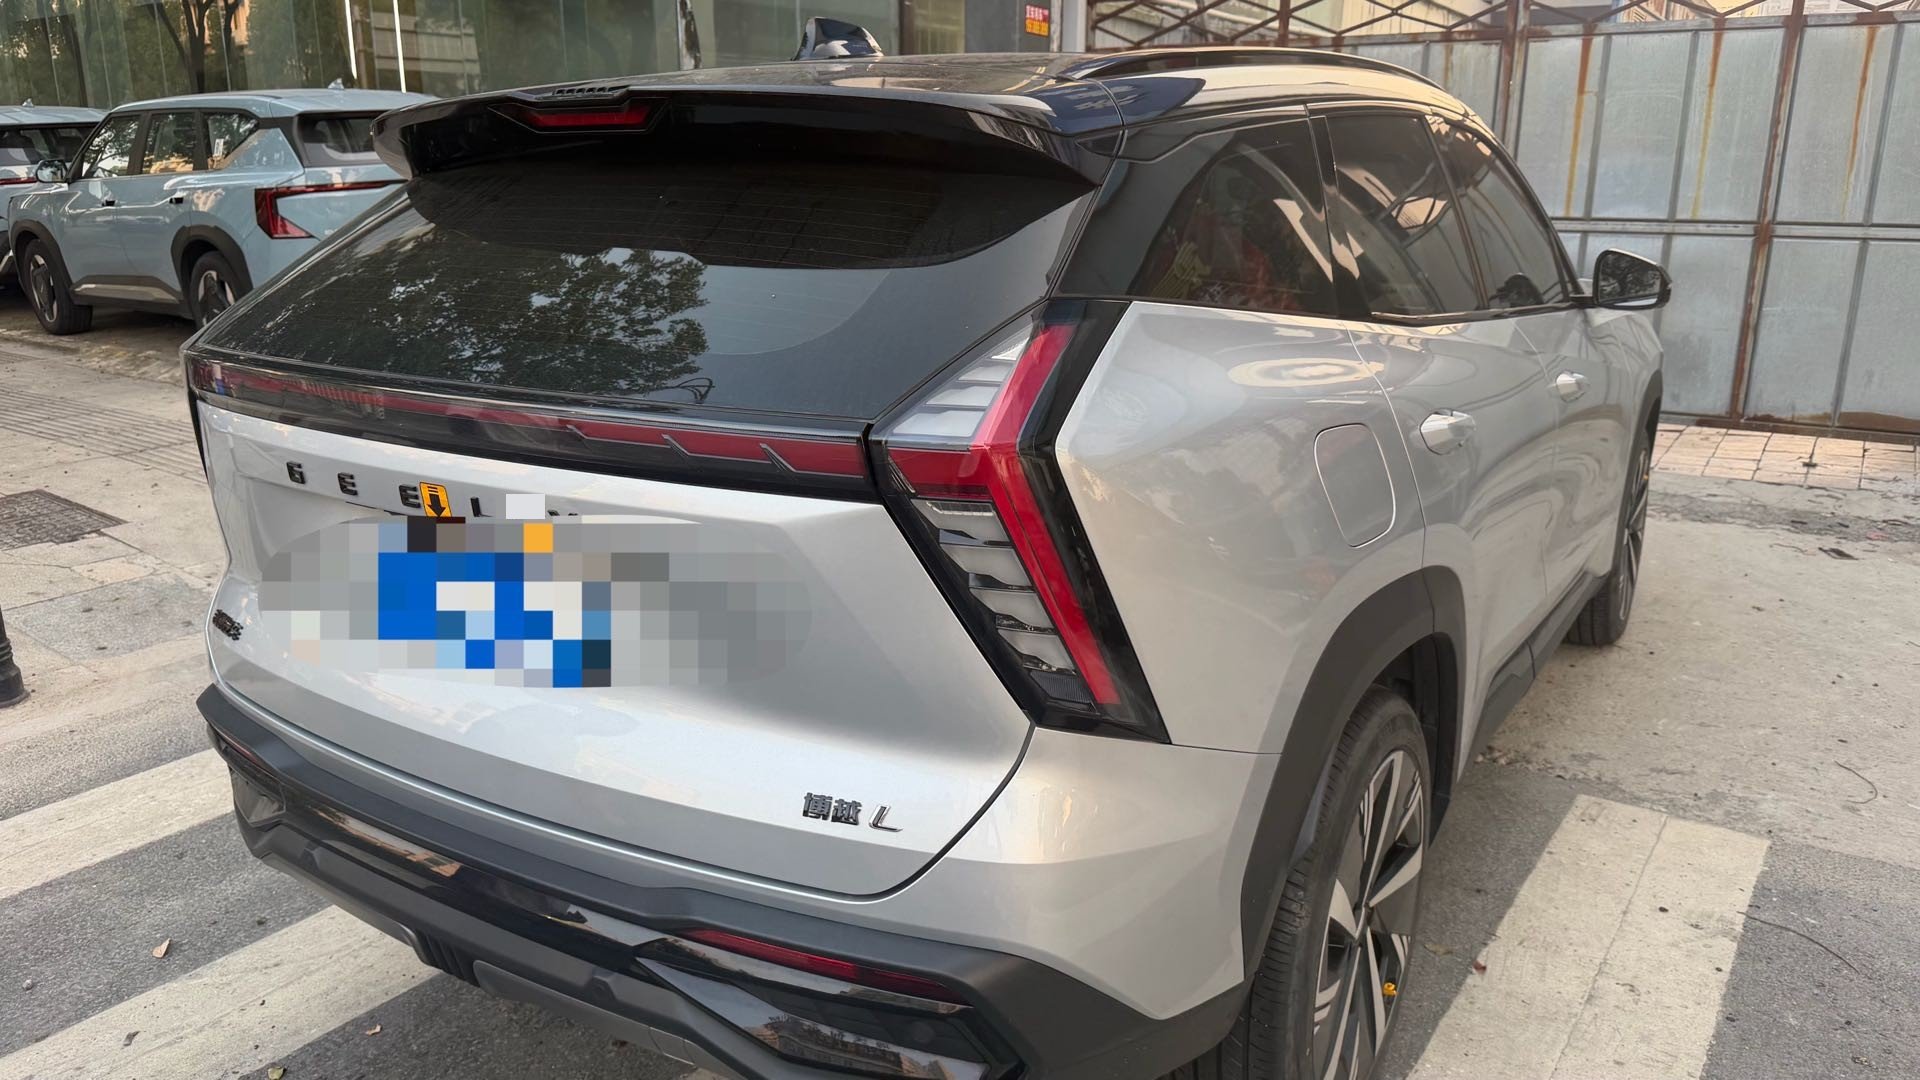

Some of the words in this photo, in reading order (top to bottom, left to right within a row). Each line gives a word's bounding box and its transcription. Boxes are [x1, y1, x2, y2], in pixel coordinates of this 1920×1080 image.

[286, 461, 579, 518] GEEL
[803, 792, 862, 825] 博越
[868, 804, 904, 832] L
